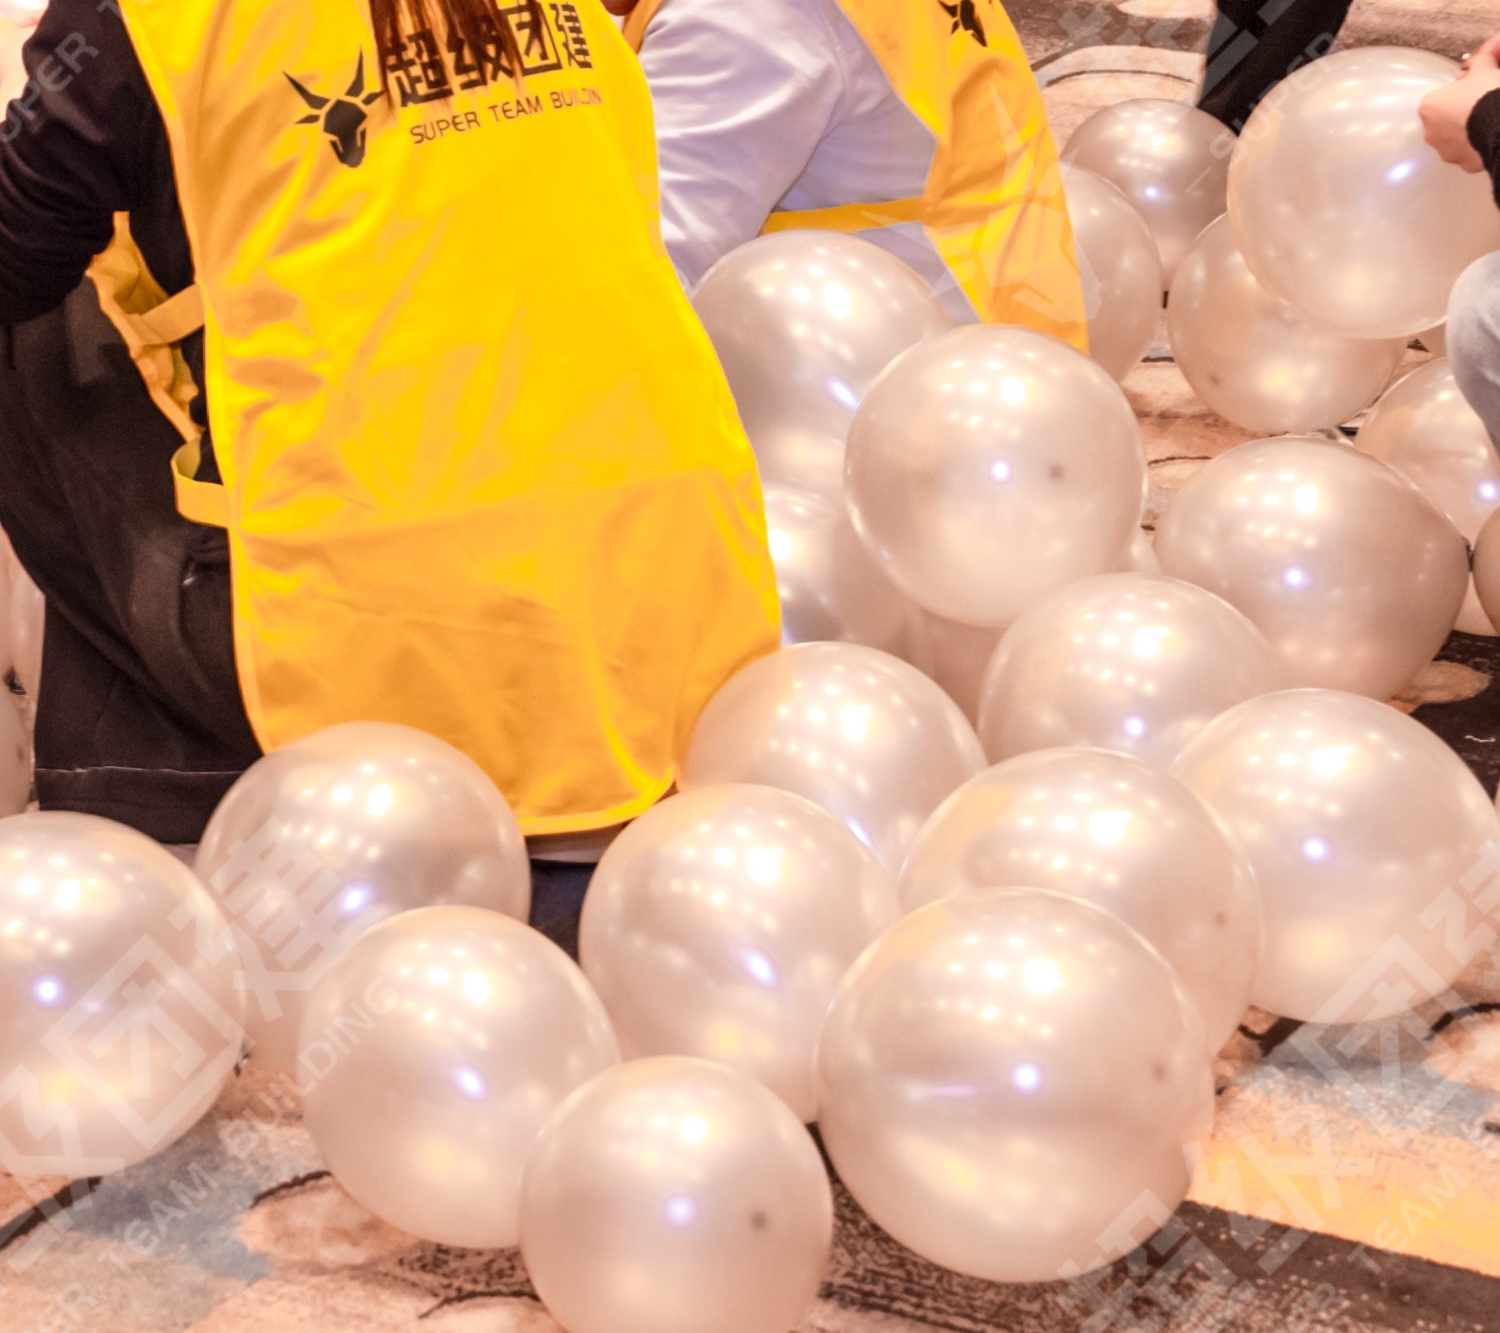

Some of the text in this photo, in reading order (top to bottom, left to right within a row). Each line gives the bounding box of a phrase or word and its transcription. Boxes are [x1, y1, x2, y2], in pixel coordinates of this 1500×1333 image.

[386, 1, 593, 108] 超级团建
[410, 111, 481, 145] SUPER
[488, 95, 544, 122] TEAM
